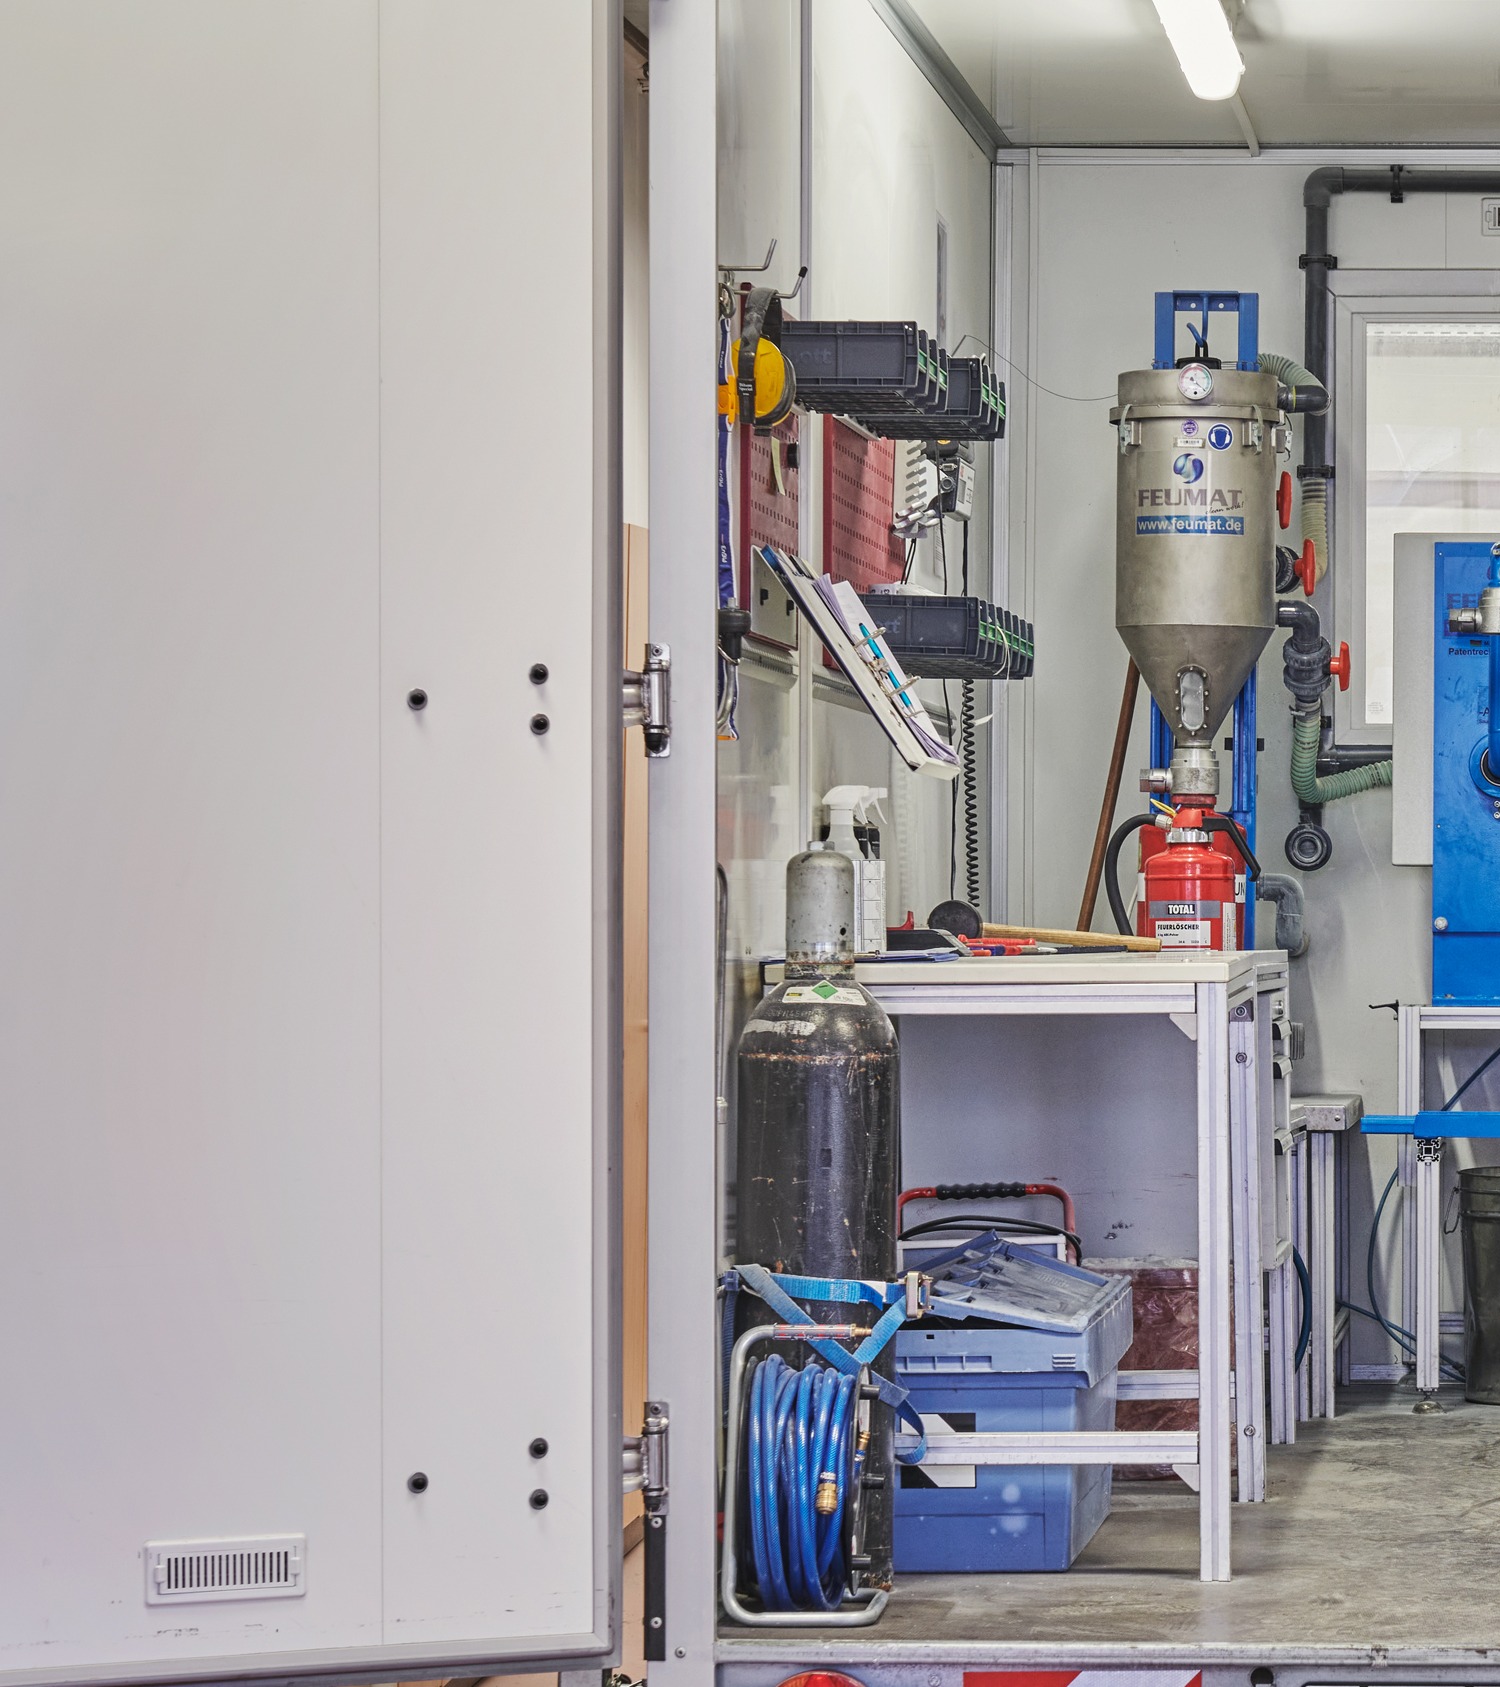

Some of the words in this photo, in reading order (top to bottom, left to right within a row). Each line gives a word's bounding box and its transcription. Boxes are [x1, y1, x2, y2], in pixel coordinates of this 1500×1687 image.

[1138, 488, 1242, 507] FEUMAT
[1138, 517, 1241, 531] www.feumat.de
[1168, 905, 1195, 914] TOTAL
